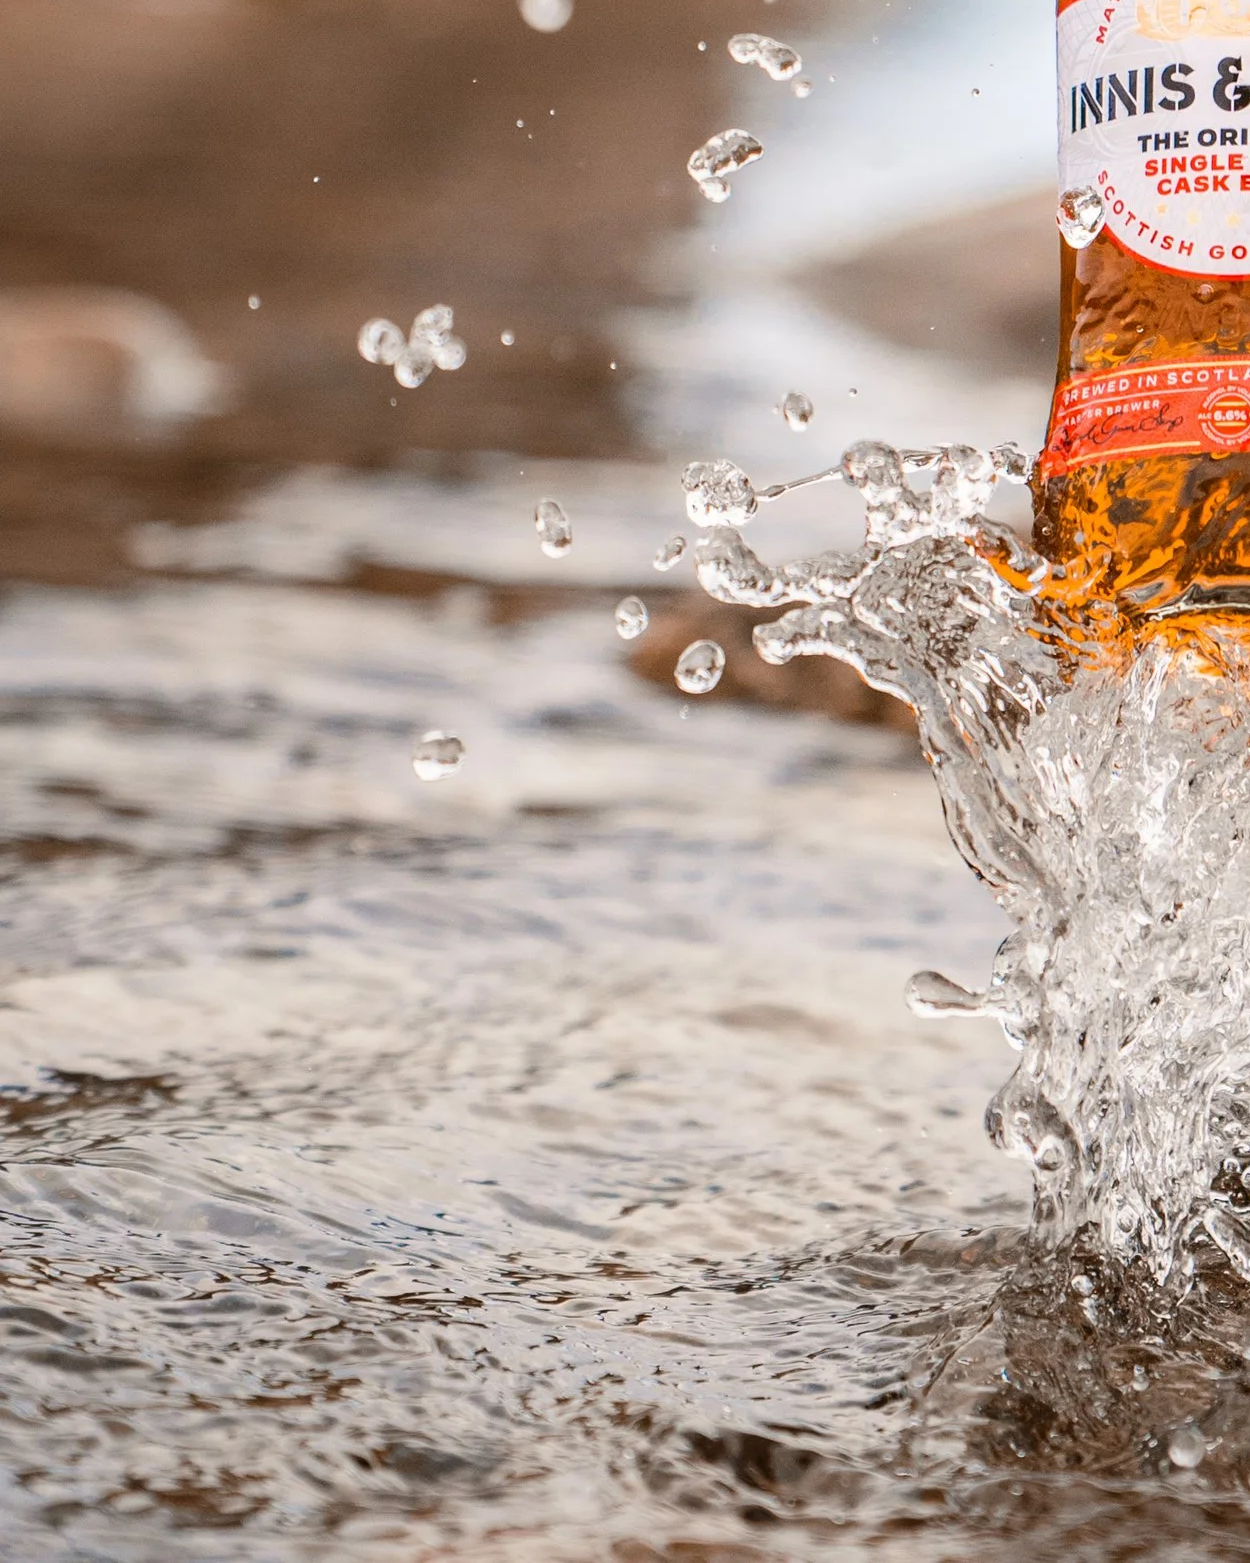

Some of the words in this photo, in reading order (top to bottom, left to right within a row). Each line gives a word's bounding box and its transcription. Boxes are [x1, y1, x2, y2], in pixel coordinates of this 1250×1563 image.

[1071, 61, 1196, 135] INNIS
[1137, 130, 1190, 153] THE
[1144, 154, 1244, 177] SINGLE
[1157, 175, 1232, 196] CASK
[1098, 170, 1194, 257] SCOTTISH
[1138, 375, 1158, 388] IN
[1106, 399, 1160, 416] BREWER
